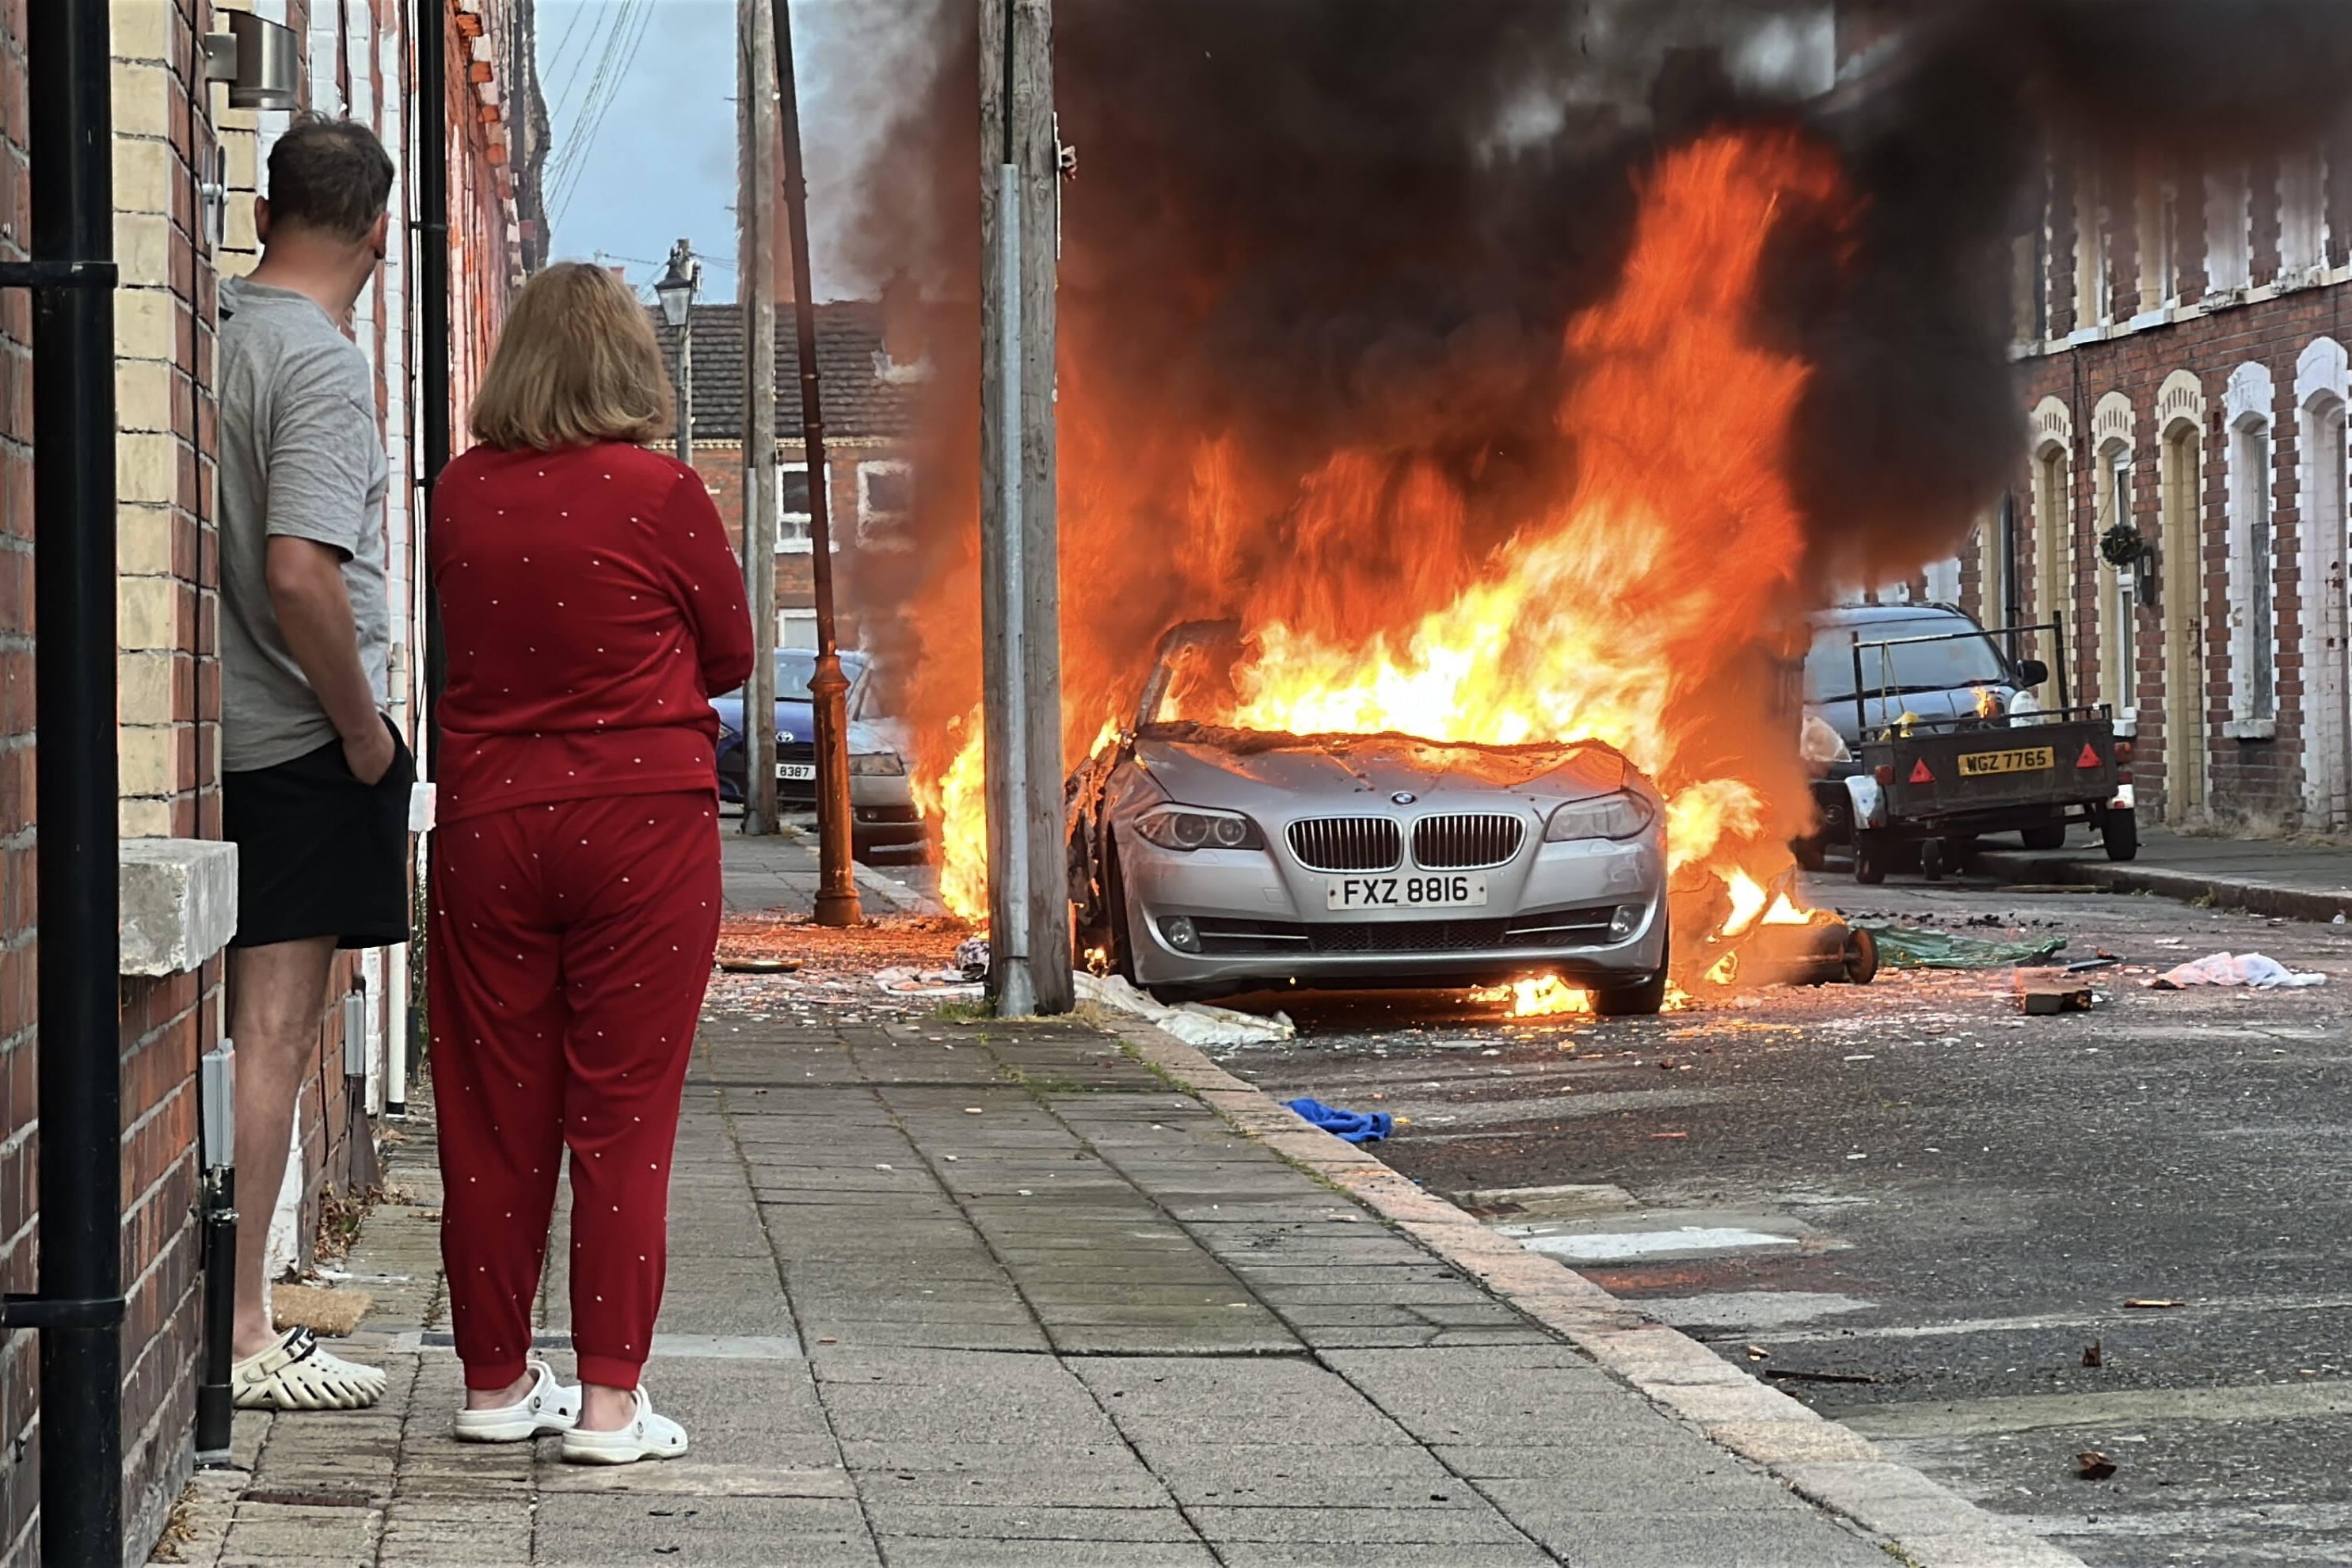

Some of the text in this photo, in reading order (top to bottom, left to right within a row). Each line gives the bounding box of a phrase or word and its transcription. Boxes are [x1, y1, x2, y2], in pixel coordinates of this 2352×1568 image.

[780, 766, 809, 778] 8387
[1966, 750, 2046, 772] WGZ 7765
[1344, 877, 1468, 904] FXZ 8816
